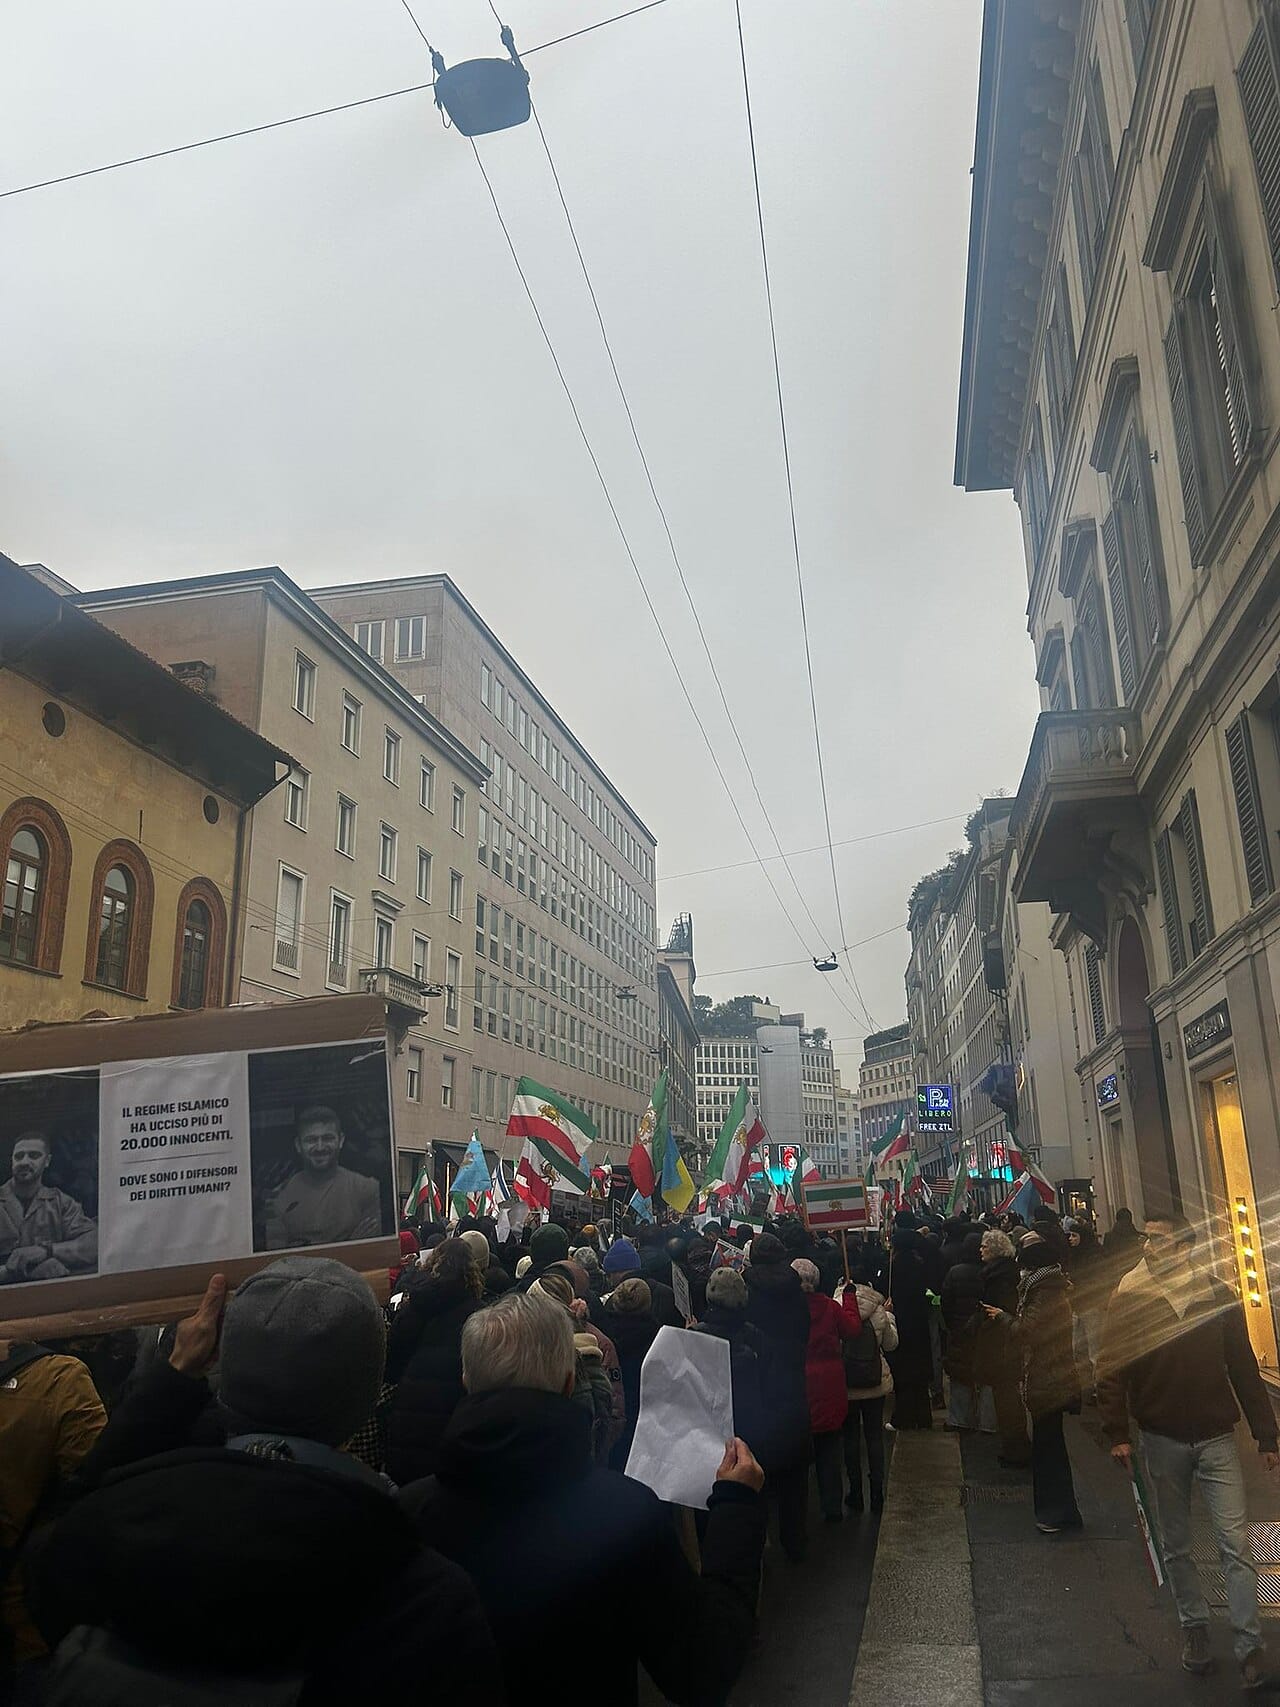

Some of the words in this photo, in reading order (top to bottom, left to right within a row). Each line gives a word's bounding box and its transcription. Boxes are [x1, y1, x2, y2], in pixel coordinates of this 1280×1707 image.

[122, 1107, 132, 1118] IL
[135, 1103, 176, 1117] REGIME
[178, 1097, 229, 1112] ISLAMICO
[130, 1122, 147, 1133] HA
[149, 1117, 189, 1131] UCCISO
[191, 1113, 209, 1126] PIÙ
[212, 1114, 222, 1125] DI
[919, 1123, 938, 1131] FREE
[938, 1123, 952, 1131] ZTL
[120, 1135, 167, 1151] 20.000
[169, 1130, 233, 1146] INNOCENTI.
[119, 1174, 147, 1187] DOVE
[149, 1170, 178, 1183] SONO
[180, 1170, 184, 1180] I
[186, 1165, 238, 1179] DIFENSORI
[130, 1190, 147, 1201] DEI
[149, 1186, 186, 1199] DIRITTI
[188, 1181, 231, 1195] UMANI?
